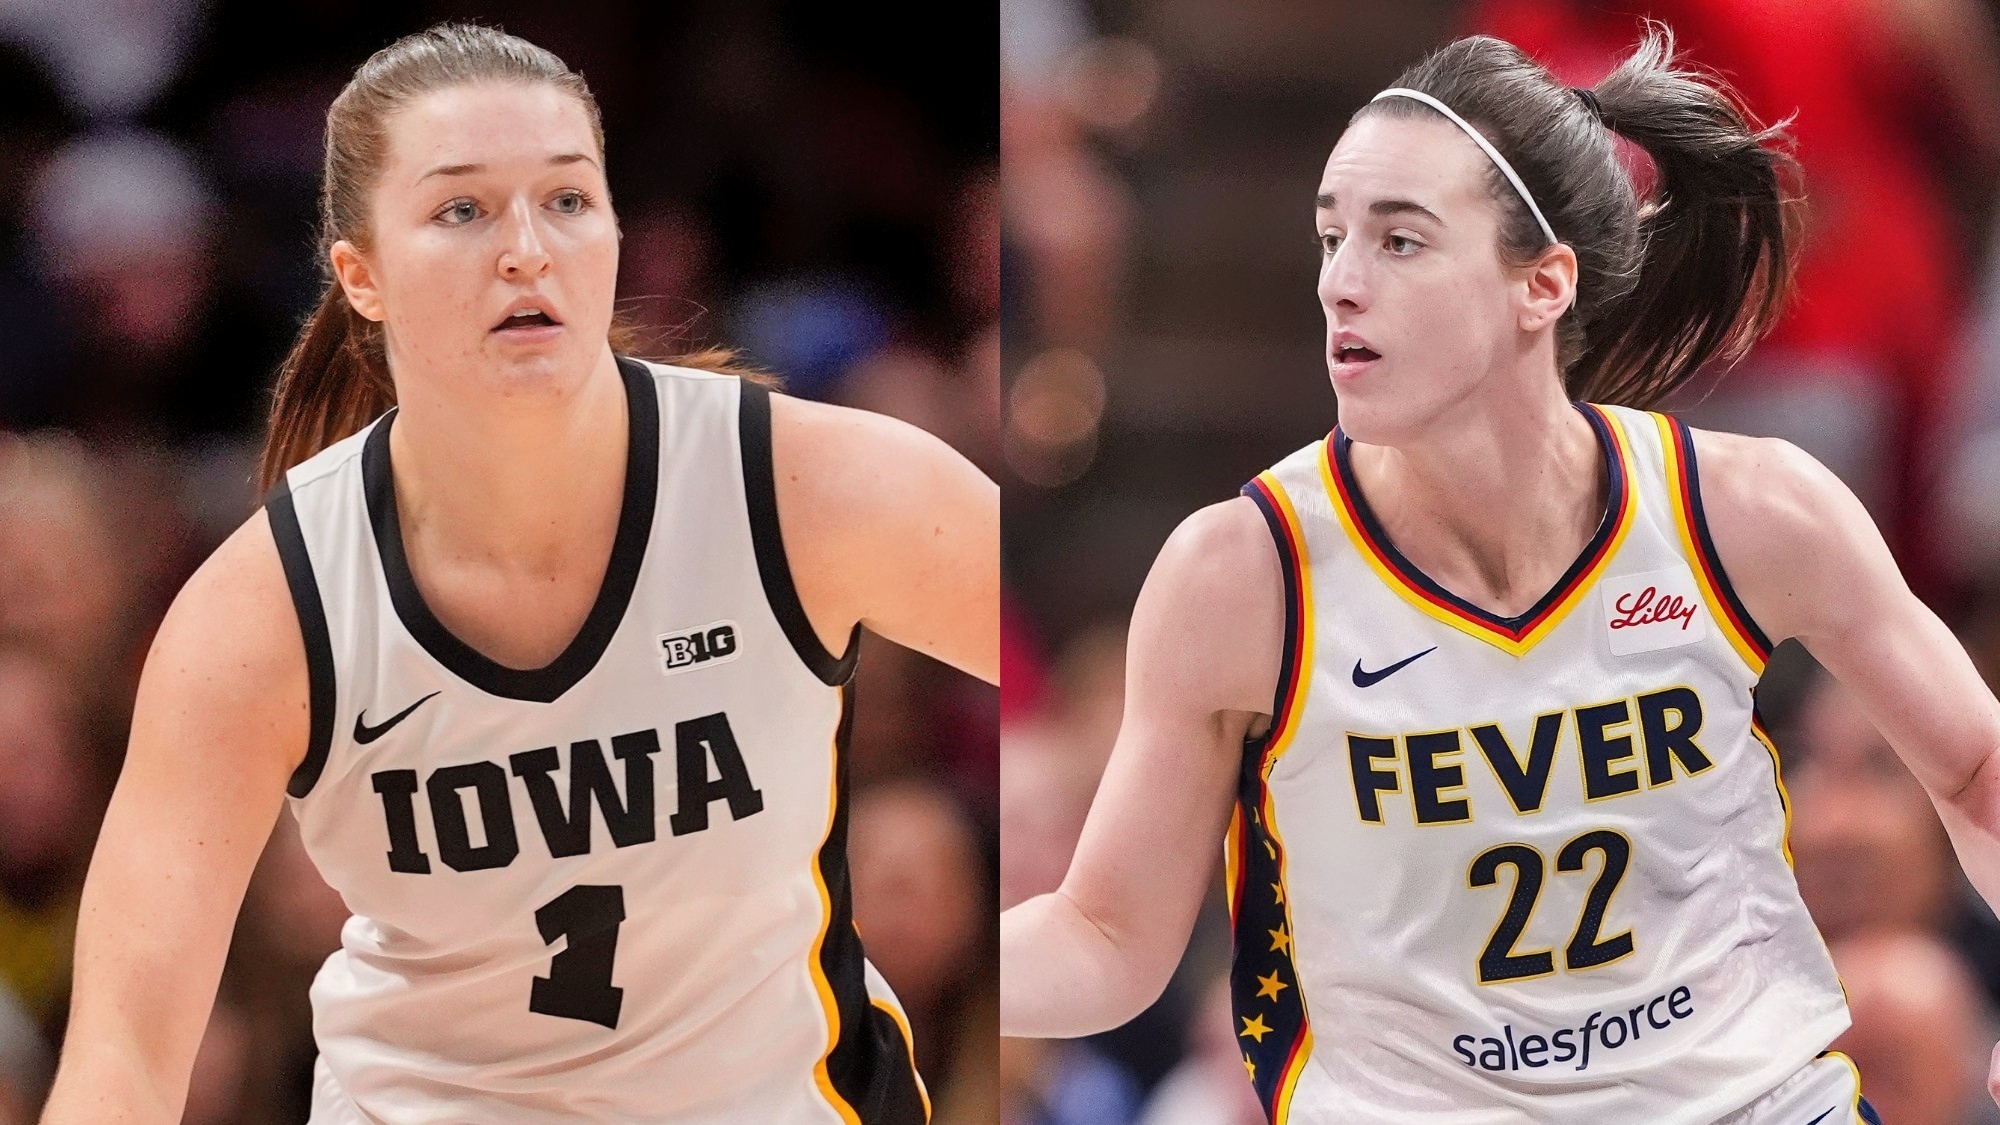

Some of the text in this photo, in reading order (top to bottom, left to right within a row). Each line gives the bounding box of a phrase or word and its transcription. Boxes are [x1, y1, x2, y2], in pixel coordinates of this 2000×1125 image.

[1610, 586, 1698, 631] Lilly
[371, 711, 764, 874] IOWA
[1344, 685, 1716, 827] FEVER
[529, 884, 626, 1030] 1
[1466, 827, 1636, 986] 22
[1453, 985, 1694, 1072] salesforce
